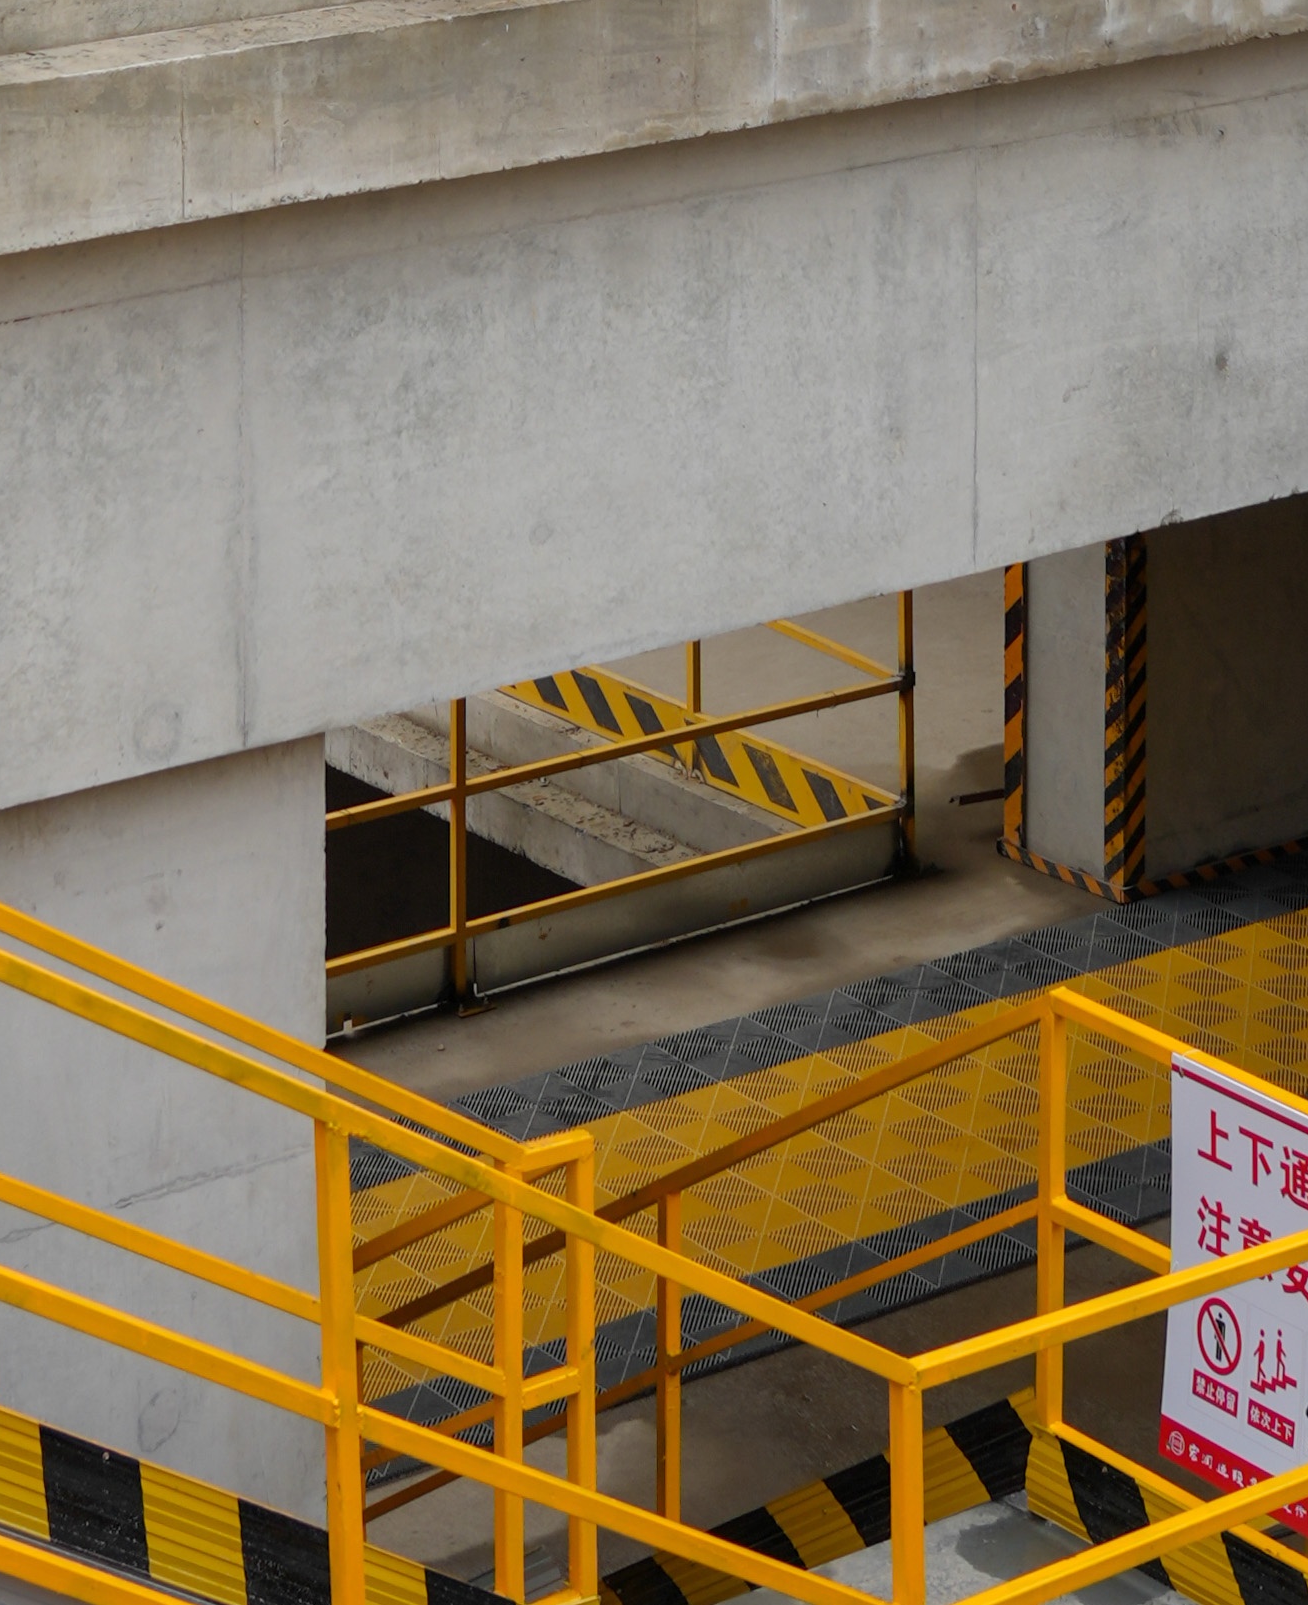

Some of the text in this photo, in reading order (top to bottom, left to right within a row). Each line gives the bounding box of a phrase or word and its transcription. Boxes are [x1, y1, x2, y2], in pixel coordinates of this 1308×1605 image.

[1195, 1375, 1237, 1412] 禁止停留
[1249, 1403, 1294, 1441] 依次上下
